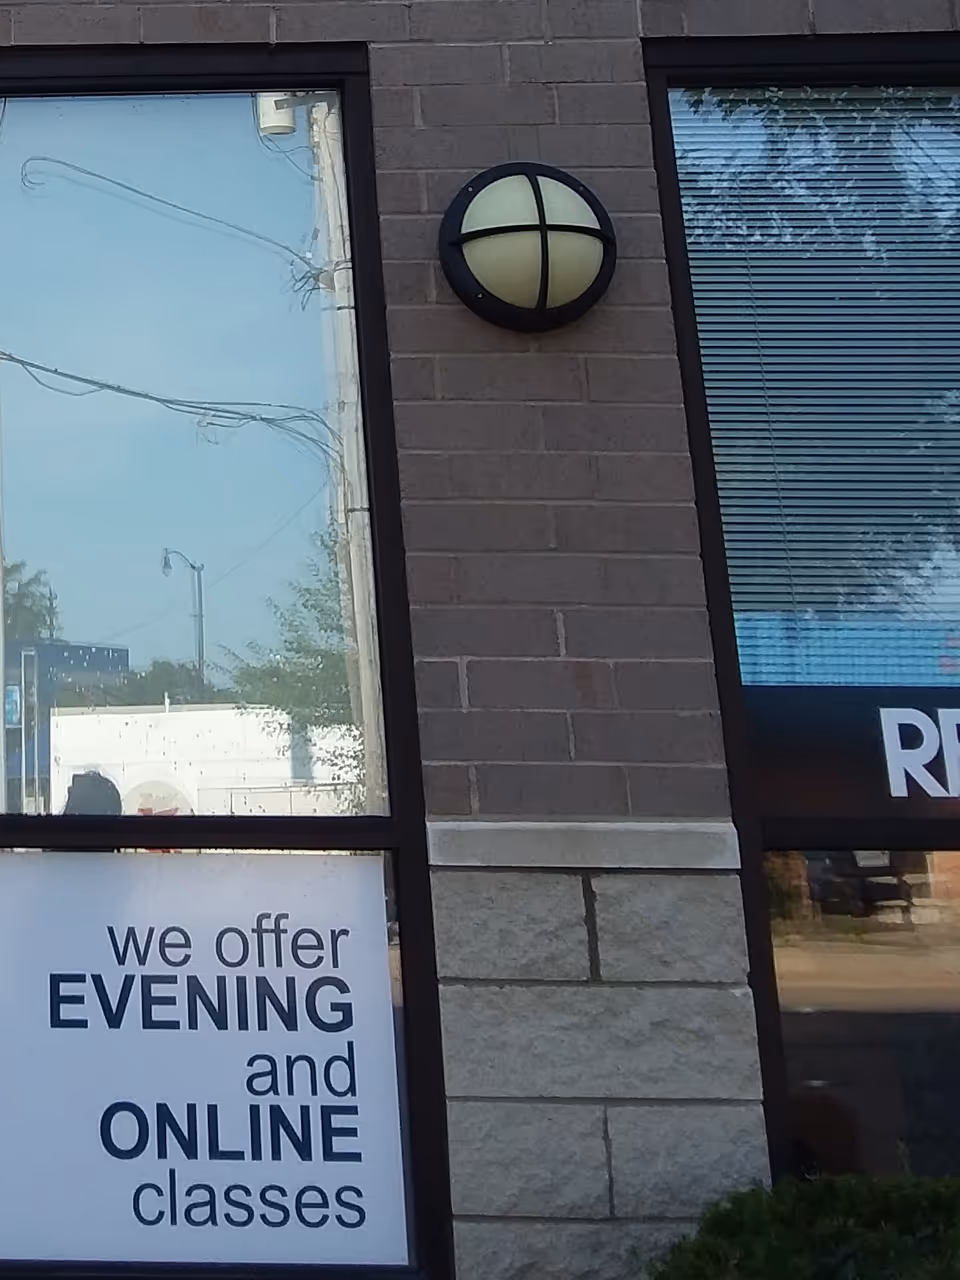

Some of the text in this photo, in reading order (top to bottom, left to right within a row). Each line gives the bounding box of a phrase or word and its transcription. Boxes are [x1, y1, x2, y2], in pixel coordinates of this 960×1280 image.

[106, 912, 350, 969] we offer
[49, 972, 354, 1033] EVENING
[245, 1040, 358, 1097] and
[99, 1101, 363, 1162] ONLINE
[132, 1168, 367, 1229] classes
